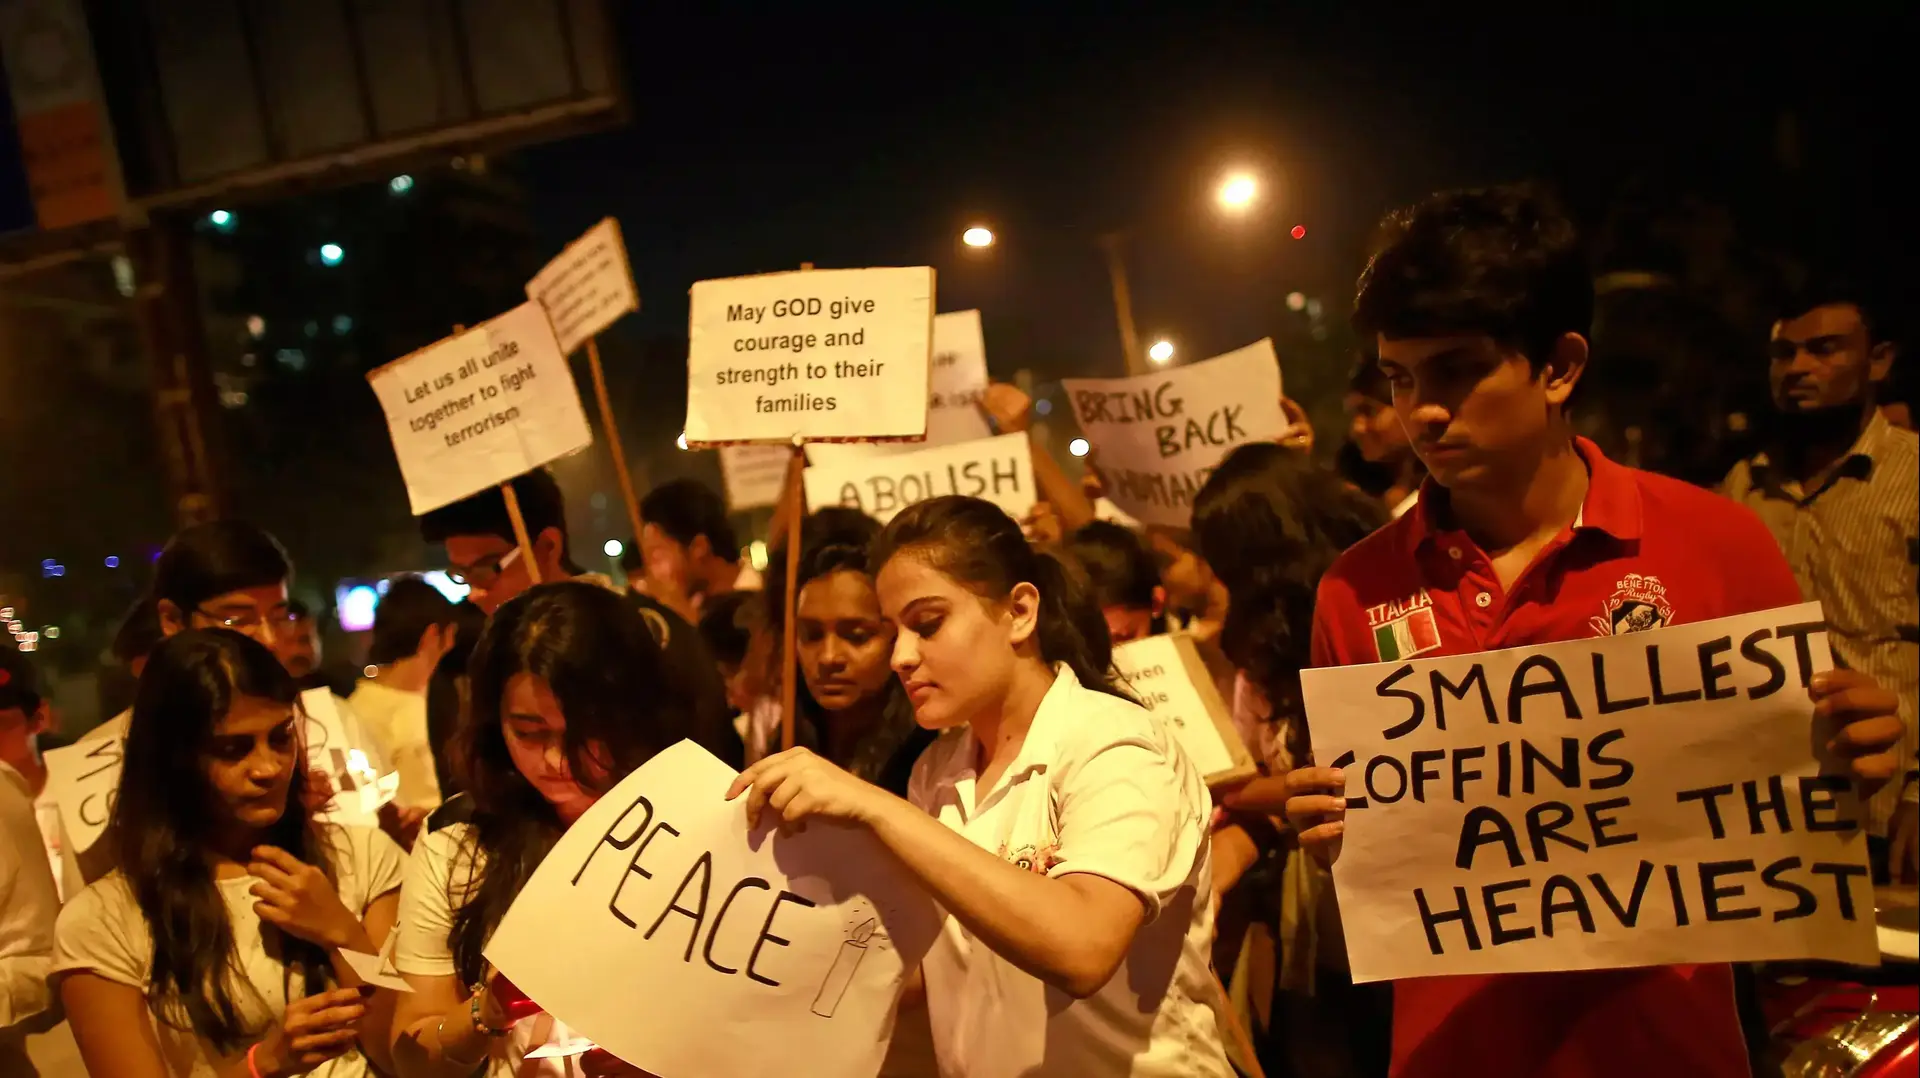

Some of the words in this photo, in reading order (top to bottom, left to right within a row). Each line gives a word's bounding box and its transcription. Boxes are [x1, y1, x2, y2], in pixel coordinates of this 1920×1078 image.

[726, 303, 767, 324] May
[772, 297, 822, 318] GOD
[829, 296, 876, 320] give
[733, 332, 818, 354] courage
[824, 327, 865, 347] and
[403, 381, 432, 404] Let
[432, 371, 455, 391] us
[458, 356, 480, 381] all
[482, 339, 520, 369] unite
[716, 361, 799, 386] strength
[806, 362, 827, 380] to
[834, 358, 885, 379] their
[408, 391, 476, 433] together
[479, 384, 498, 402] to
[499, 362, 538, 393] fight
[755, 392, 838, 414] families
[1075, 380, 1185, 424] BRING
[443, 404, 521, 447] terrorism
[1155, 403, 1248, 459] BACK
[839, 456, 1020, 512] ABOLISH
[1365, 586, 1434, 627] ITALIA
[1616, 580, 1667, 596] BENETTON
[1624, 587, 1658, 604] Rugby
[1375, 620, 1827, 740] SMALLEST
[1454, 796, 1638, 870] ARE
[1677, 775, 1858, 841] THE
[571, 795, 816, 987] PEACE
[1413, 856, 1868, 955] HEAVIEST
